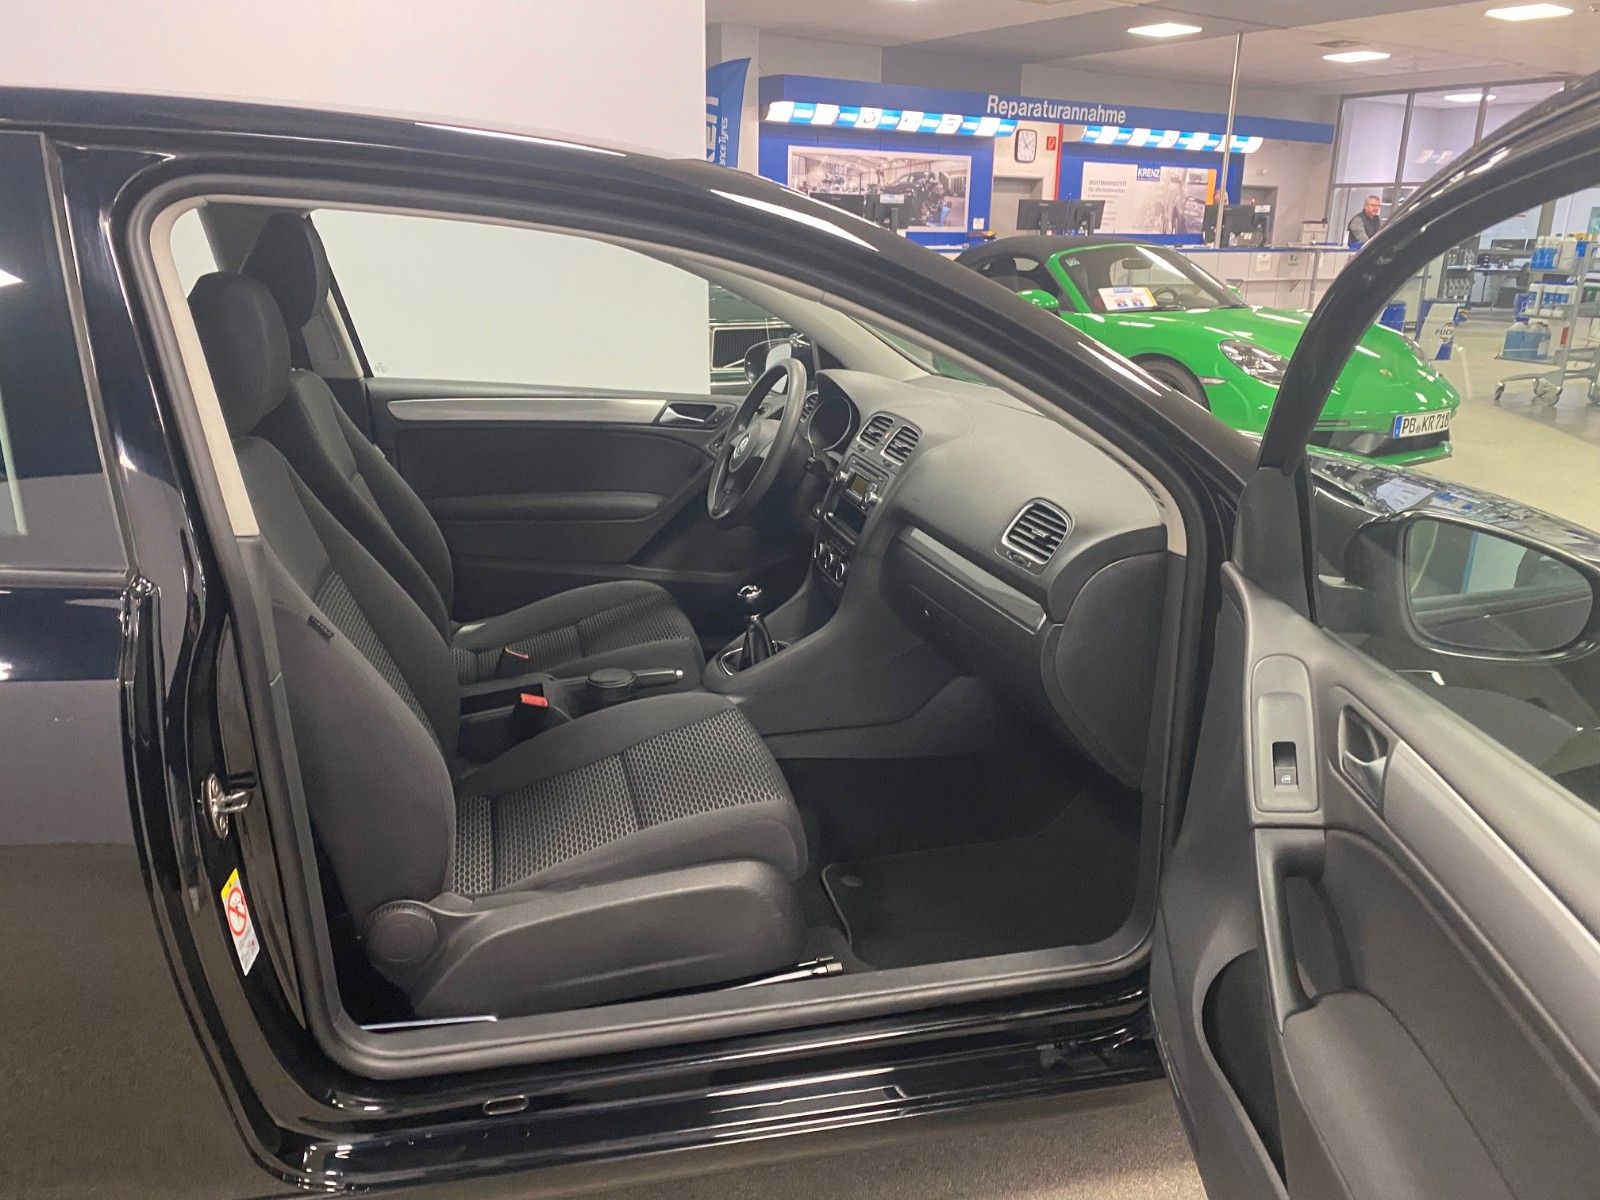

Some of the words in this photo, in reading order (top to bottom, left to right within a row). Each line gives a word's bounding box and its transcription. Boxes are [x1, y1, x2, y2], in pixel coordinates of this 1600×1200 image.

[986, 94, 1126, 123] Reparaturannahme
[719, 117, 728, 144] Tyres
[1137, 167, 1161, 178] KRENZ
[1402, 417, 1416, 433] PB
[1421, 415, 1435, 431] KR
